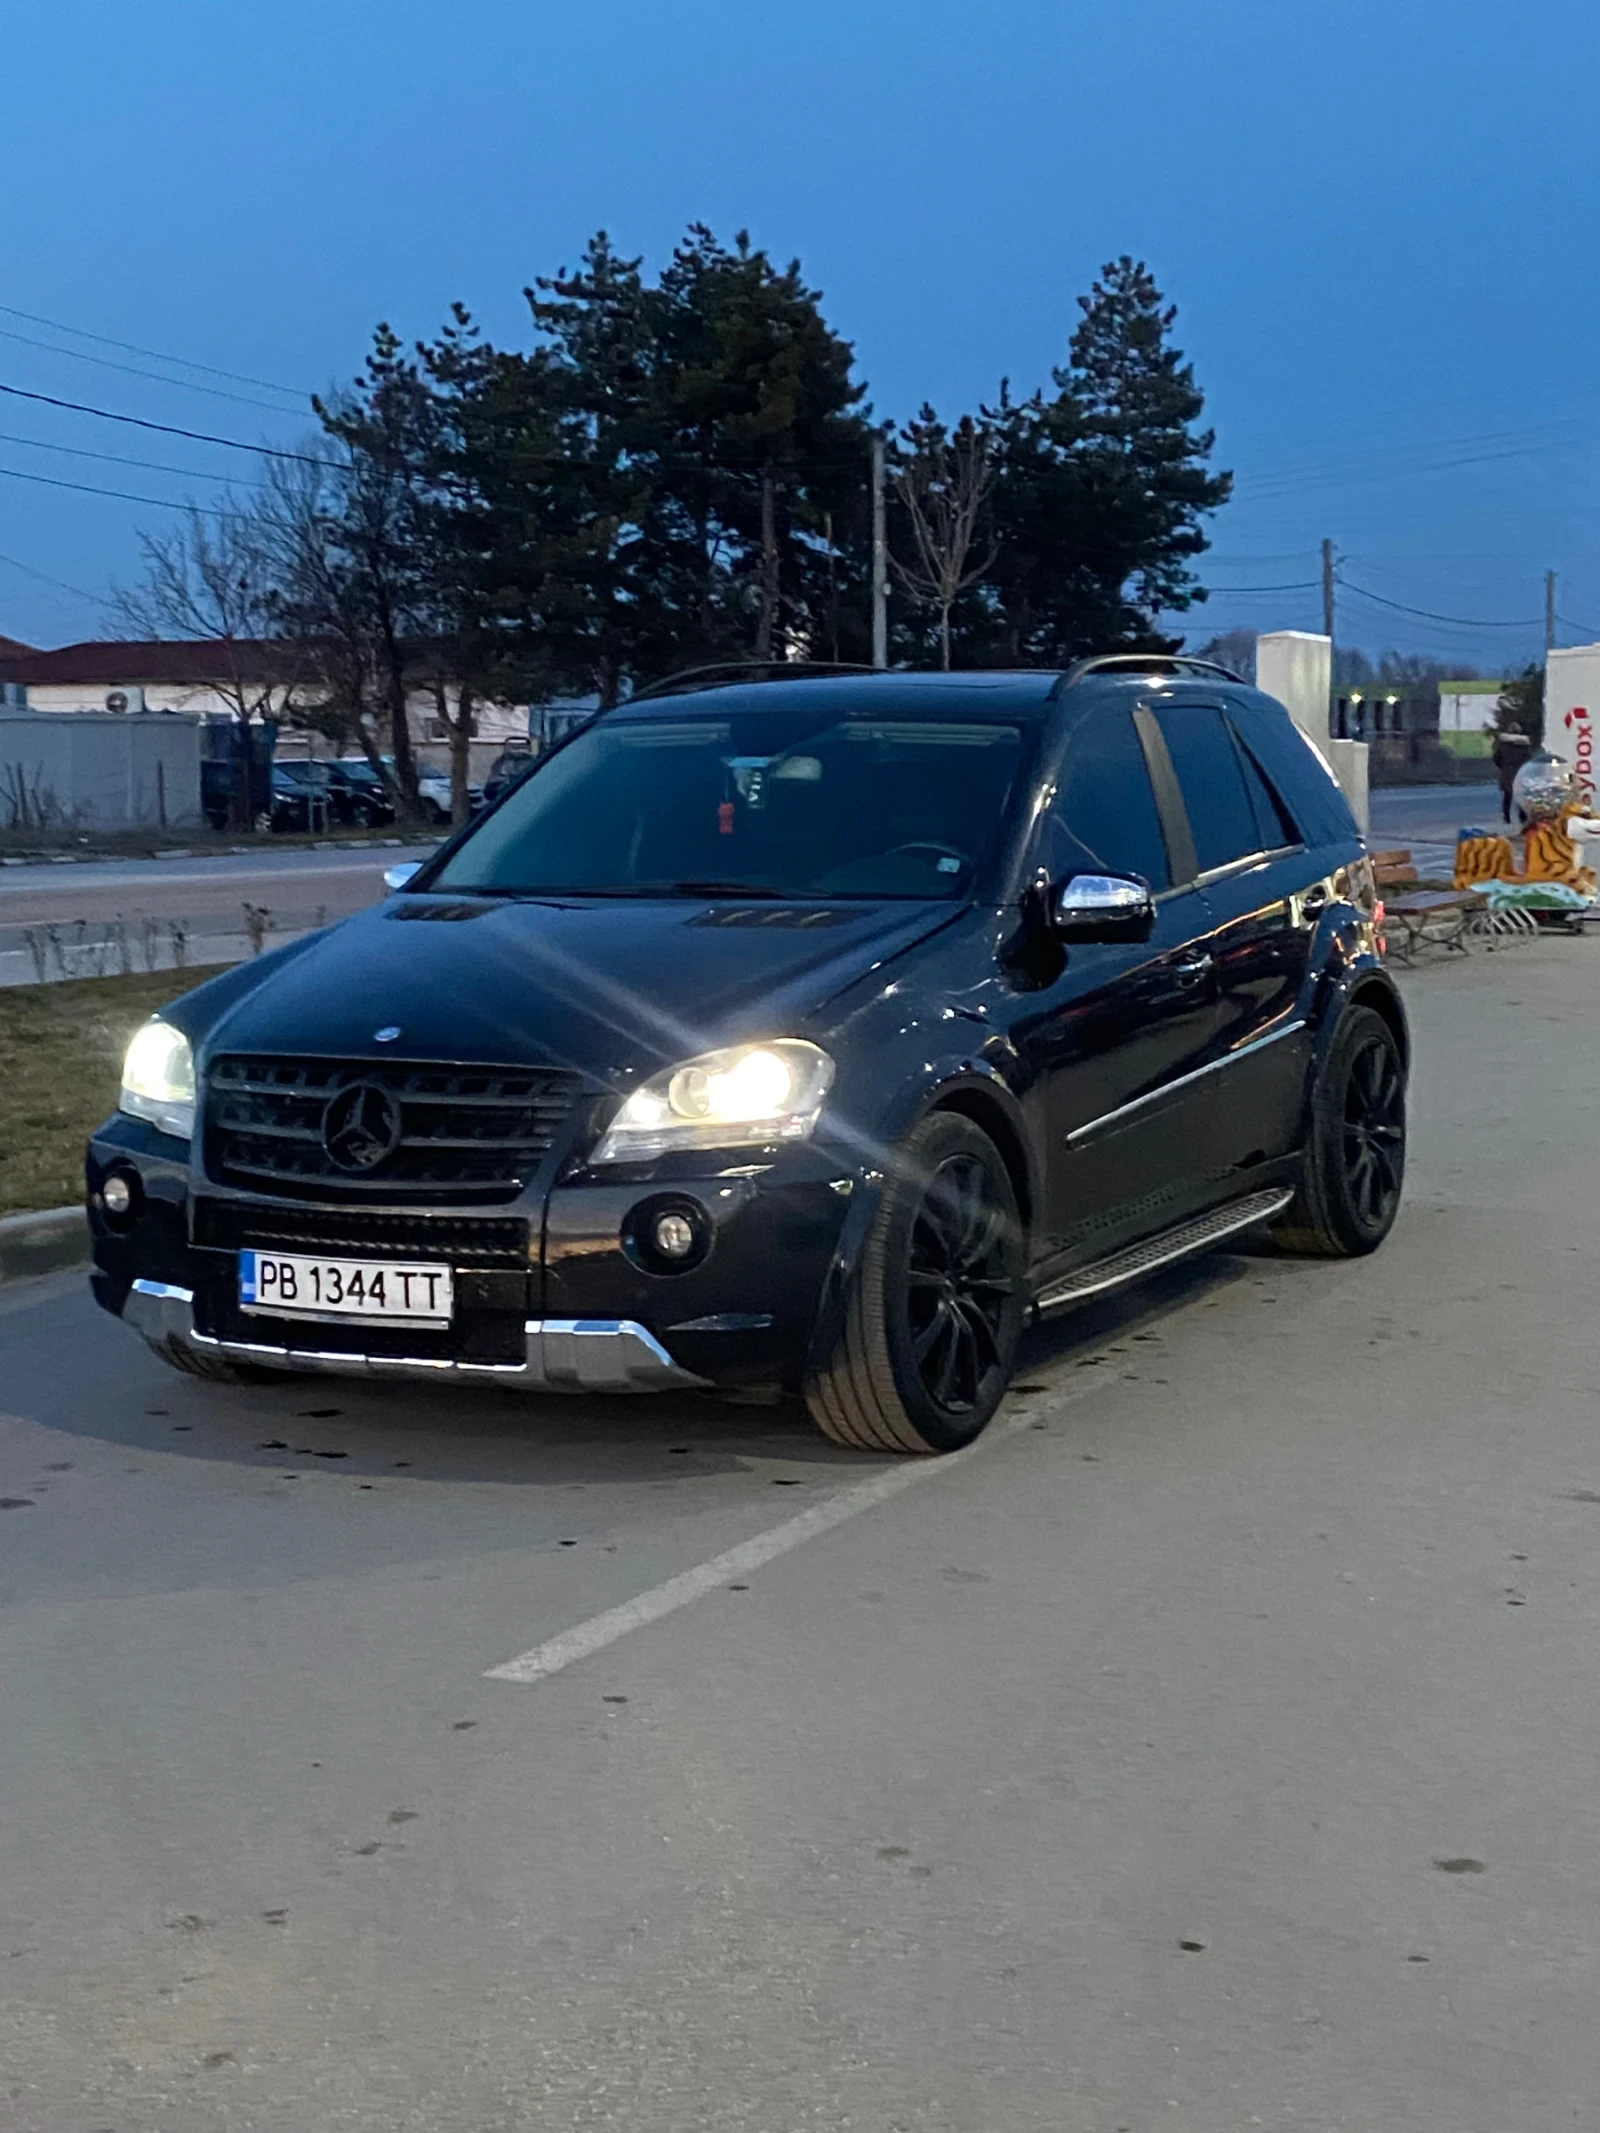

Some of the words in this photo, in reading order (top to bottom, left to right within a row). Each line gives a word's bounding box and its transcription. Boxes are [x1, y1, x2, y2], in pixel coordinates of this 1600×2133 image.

[260, 1260, 298, 1300] PB
[309, 1266, 386, 1308] 1344
[394, 1271, 442, 1310] TT
